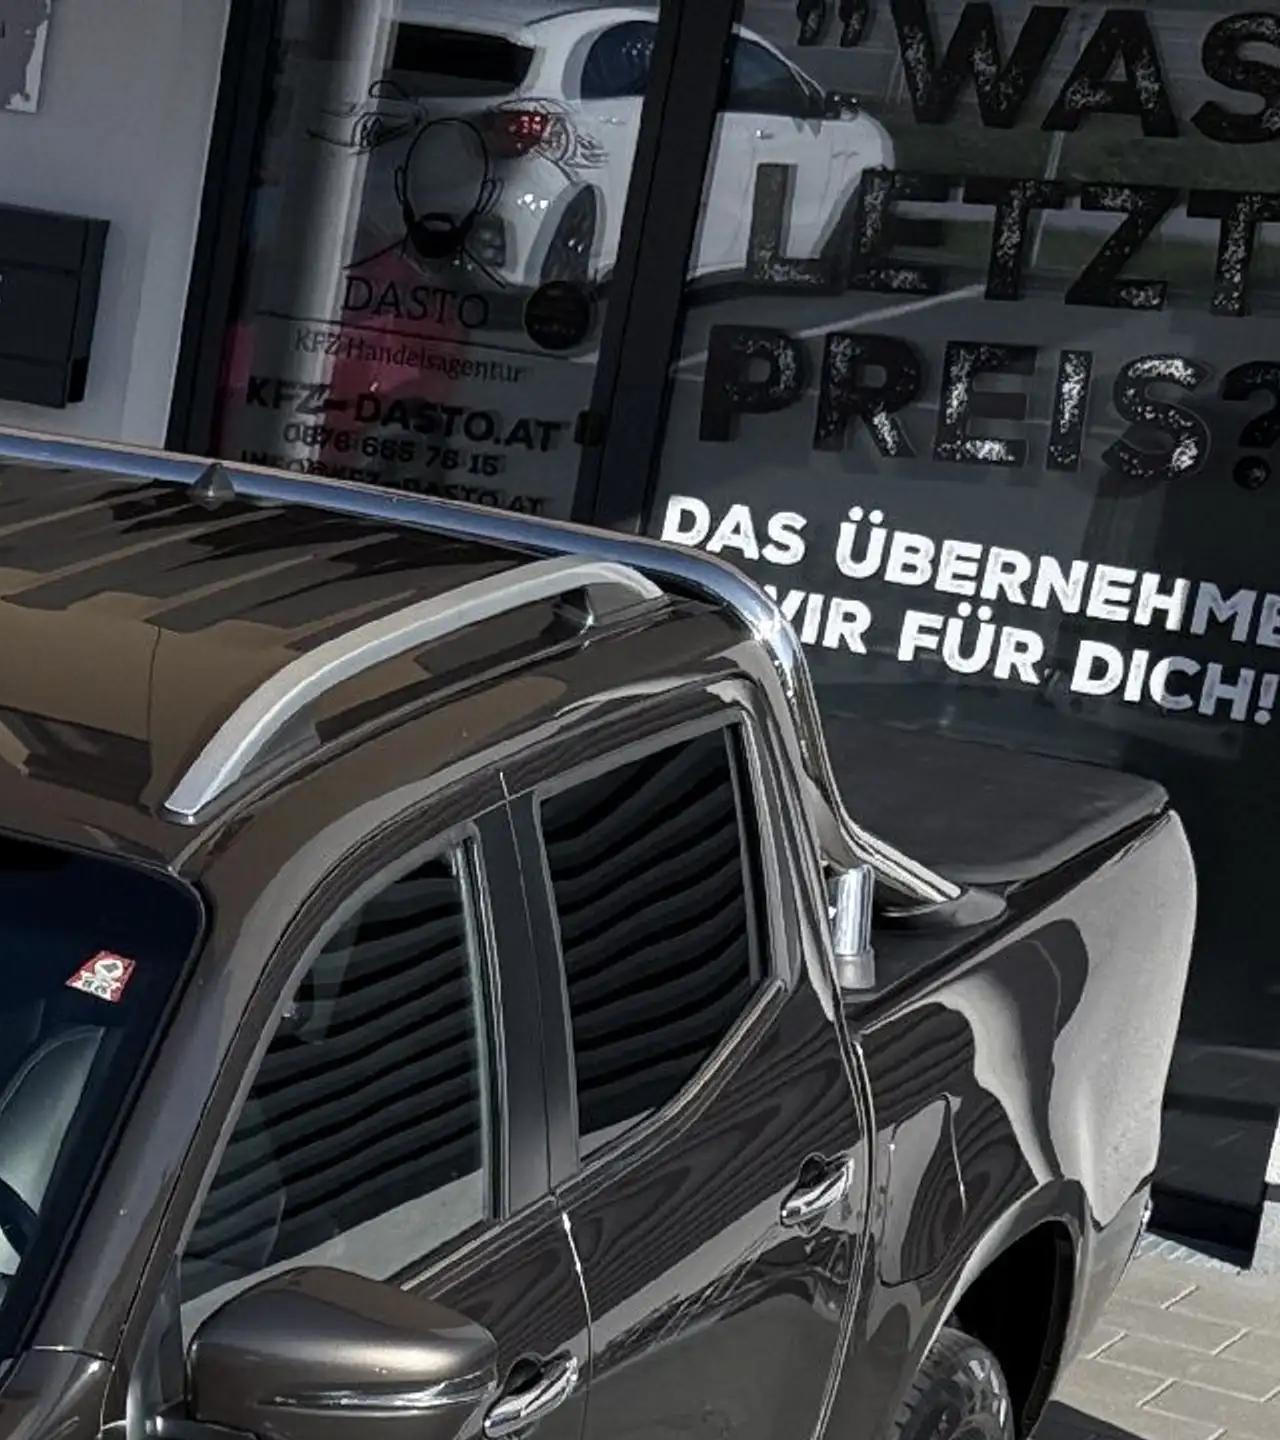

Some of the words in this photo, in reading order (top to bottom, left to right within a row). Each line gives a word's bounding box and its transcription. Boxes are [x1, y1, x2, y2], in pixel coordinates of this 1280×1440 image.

[342, 276, 489, 330] DASTO
[247, 376, 561, 451] KFZ-DASTO.AT
[699, 324, 1280, 490] PREIS?
[469, 454, 501, 477] 15
[660, 496, 808, 565] DAS
[898, 602, 1045, 685] FÜR
[1070, 640, 1280, 725] DICH!
